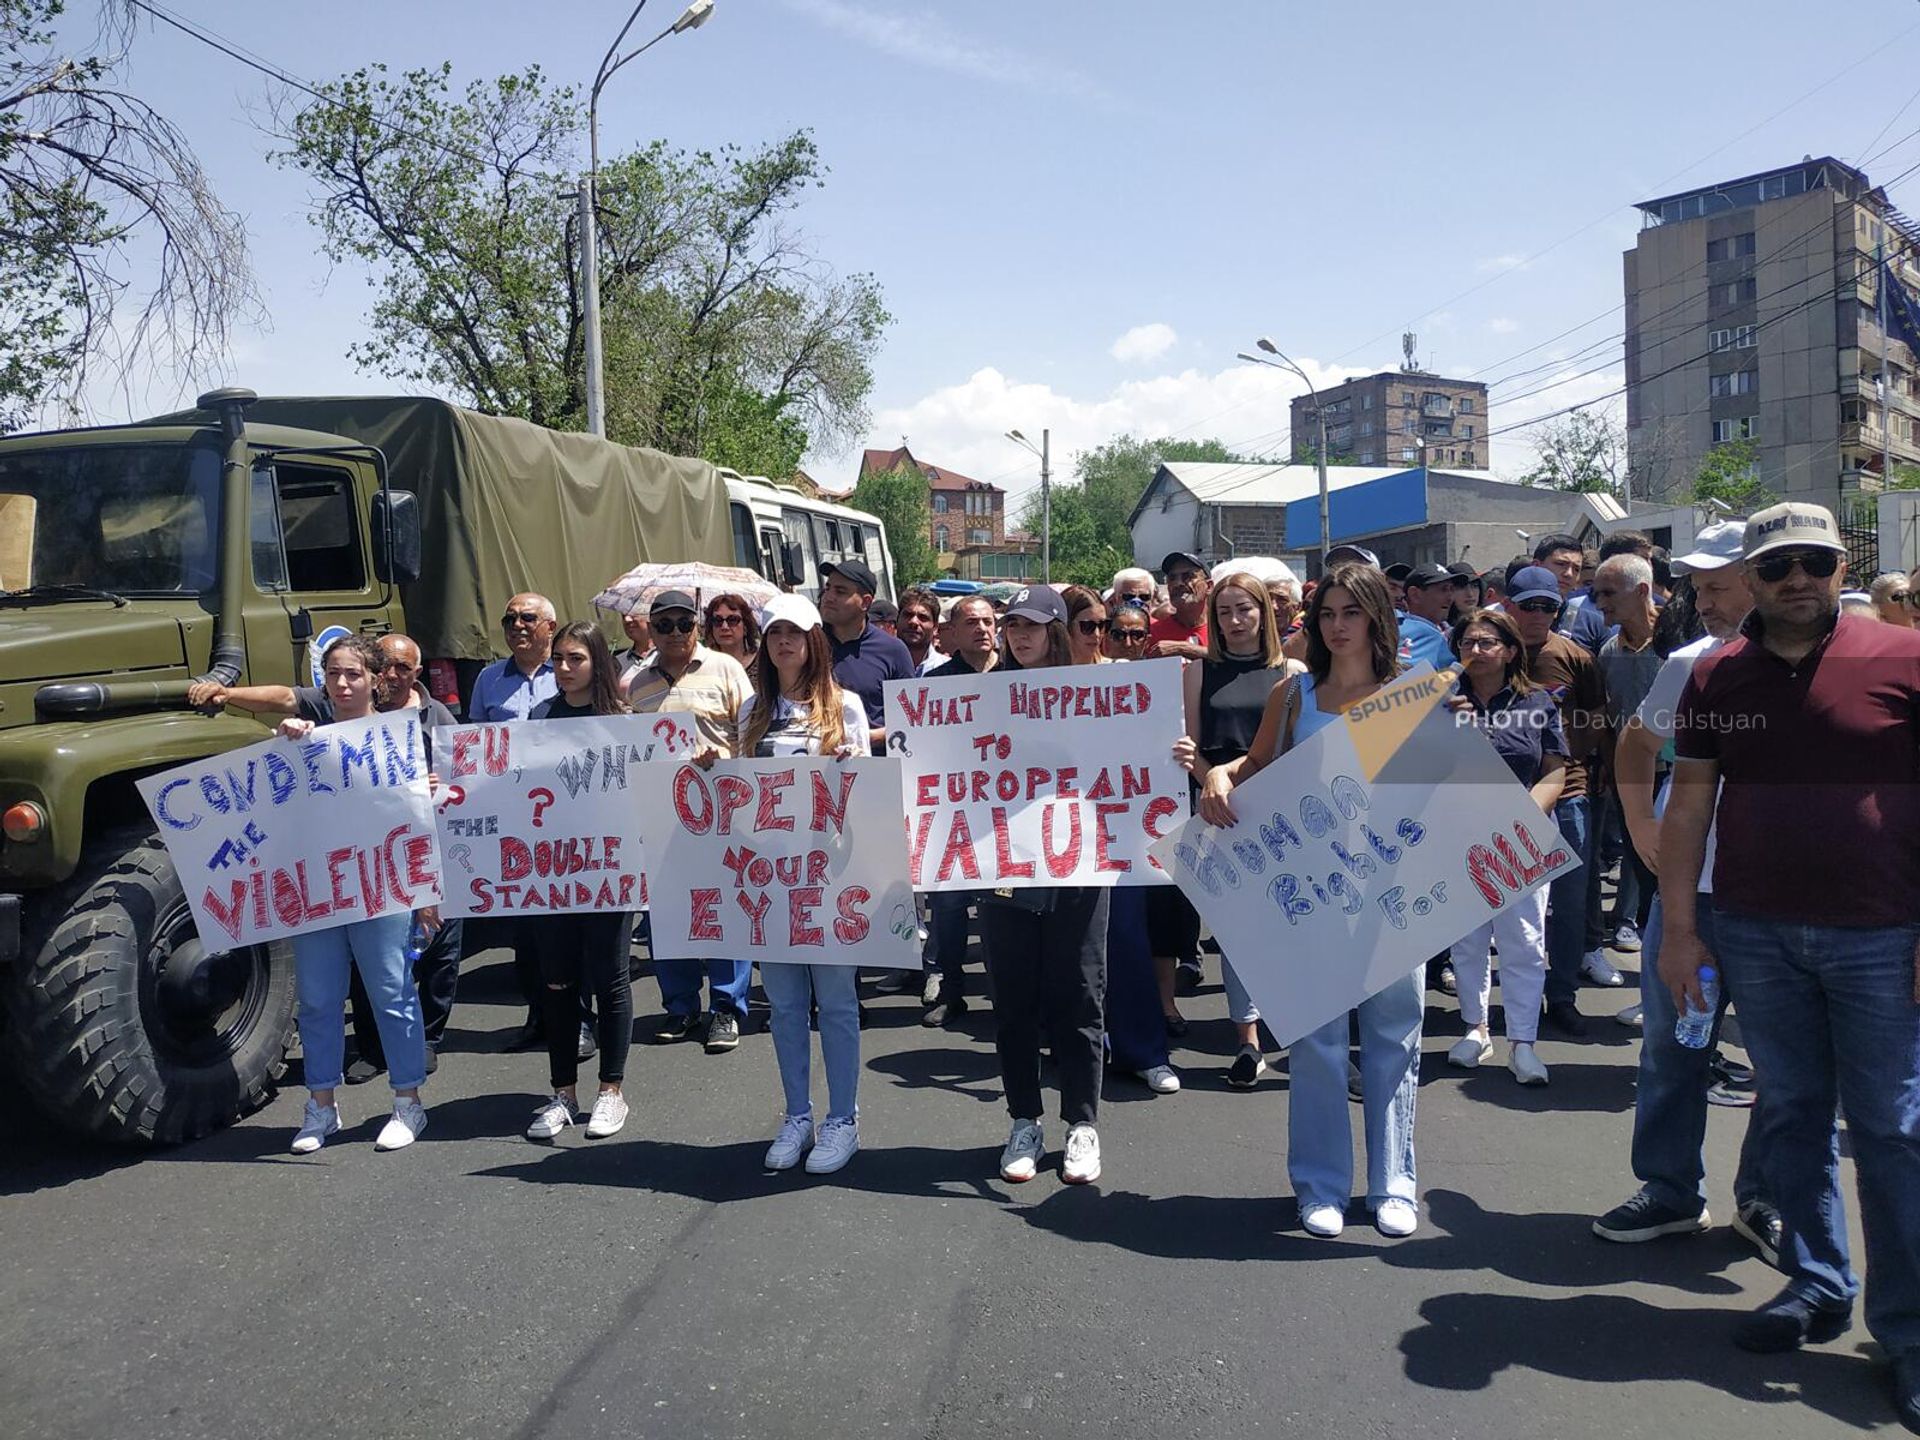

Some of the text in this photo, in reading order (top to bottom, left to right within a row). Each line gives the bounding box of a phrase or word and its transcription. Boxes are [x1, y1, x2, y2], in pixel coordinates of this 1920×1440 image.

[897, 681, 1152, 728] WHAT HAPPENED
[972, 732, 1013, 762] TO
[153, 719, 419, 832] CONDEMN
[672, 764, 858, 837] OPEN
[916, 763, 1151, 807] EUROPEAN
[206, 819, 268, 872] THE
[447, 814, 499, 837] THE
[722, 845, 831, 888] YOUR
[1376, 818, 1572, 931] For ALL
[688, 885, 872, 947] EYES
